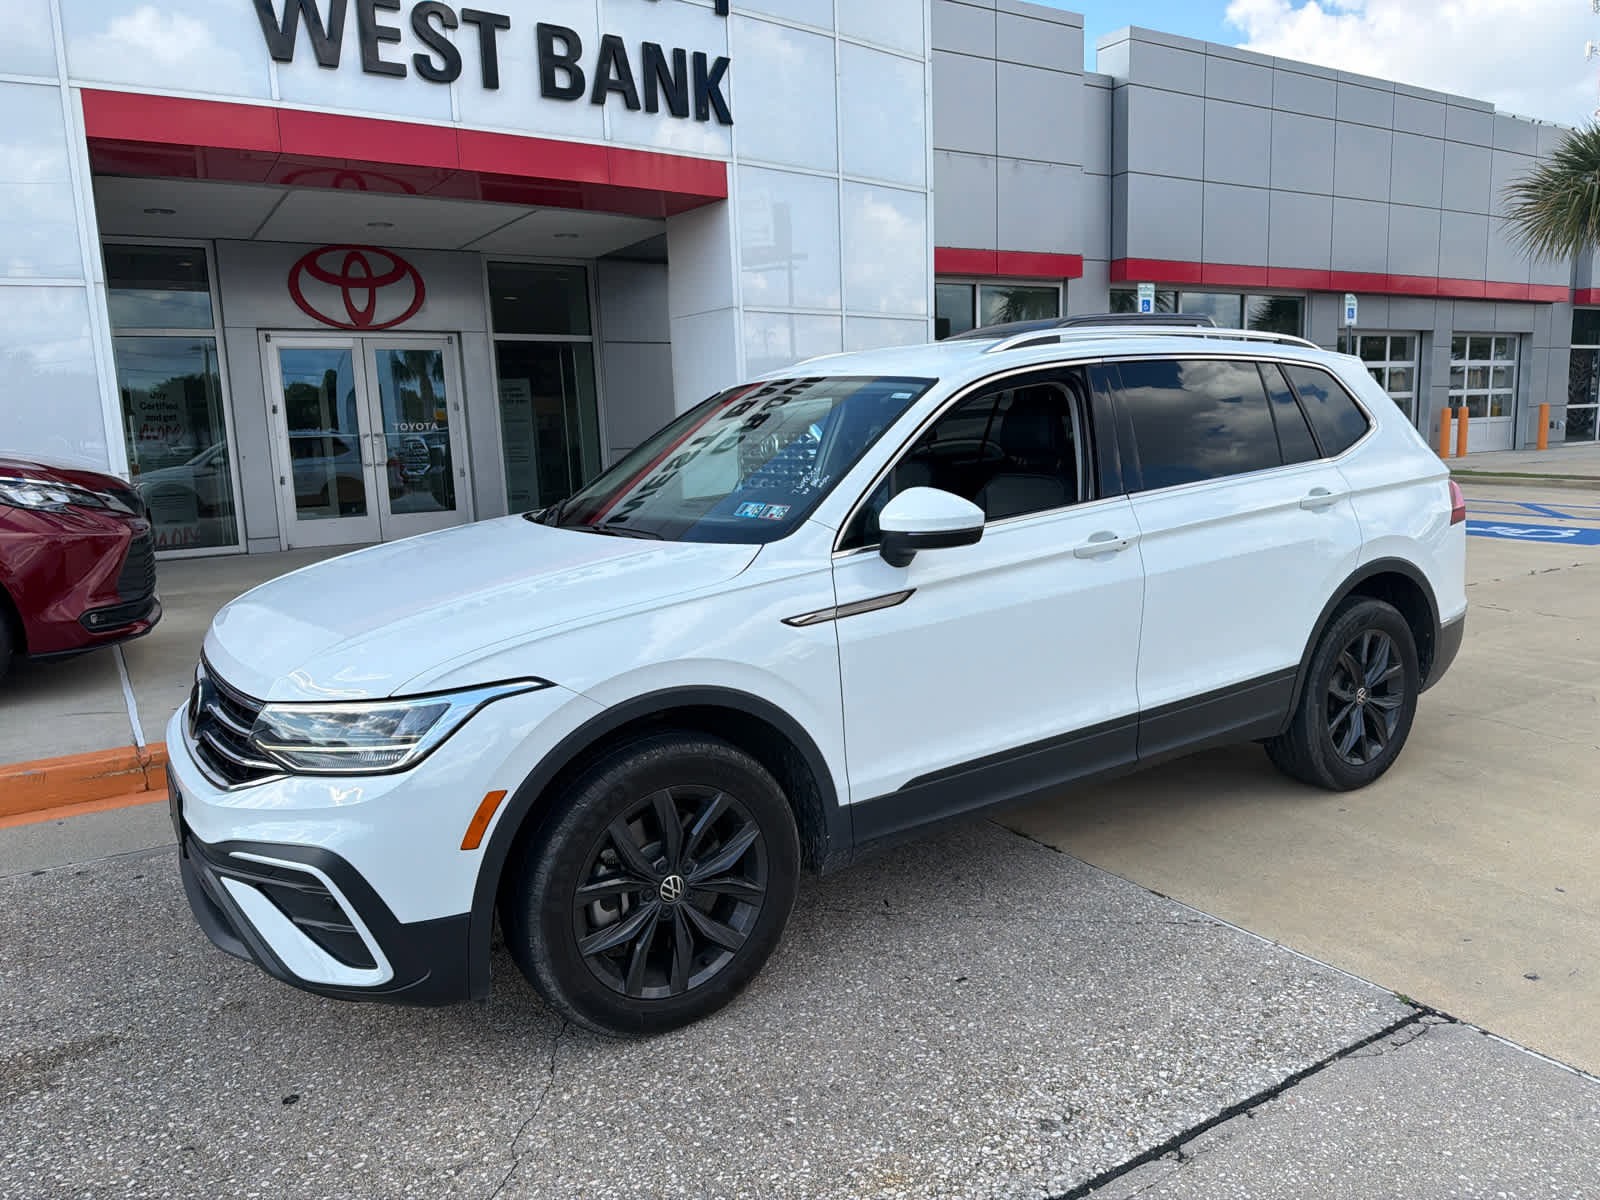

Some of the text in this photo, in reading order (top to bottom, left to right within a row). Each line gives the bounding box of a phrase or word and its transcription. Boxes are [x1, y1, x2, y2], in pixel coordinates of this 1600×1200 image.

[254, 0, 734, 126] WEST BANK
[392, 422, 439, 431] TOYOTA
